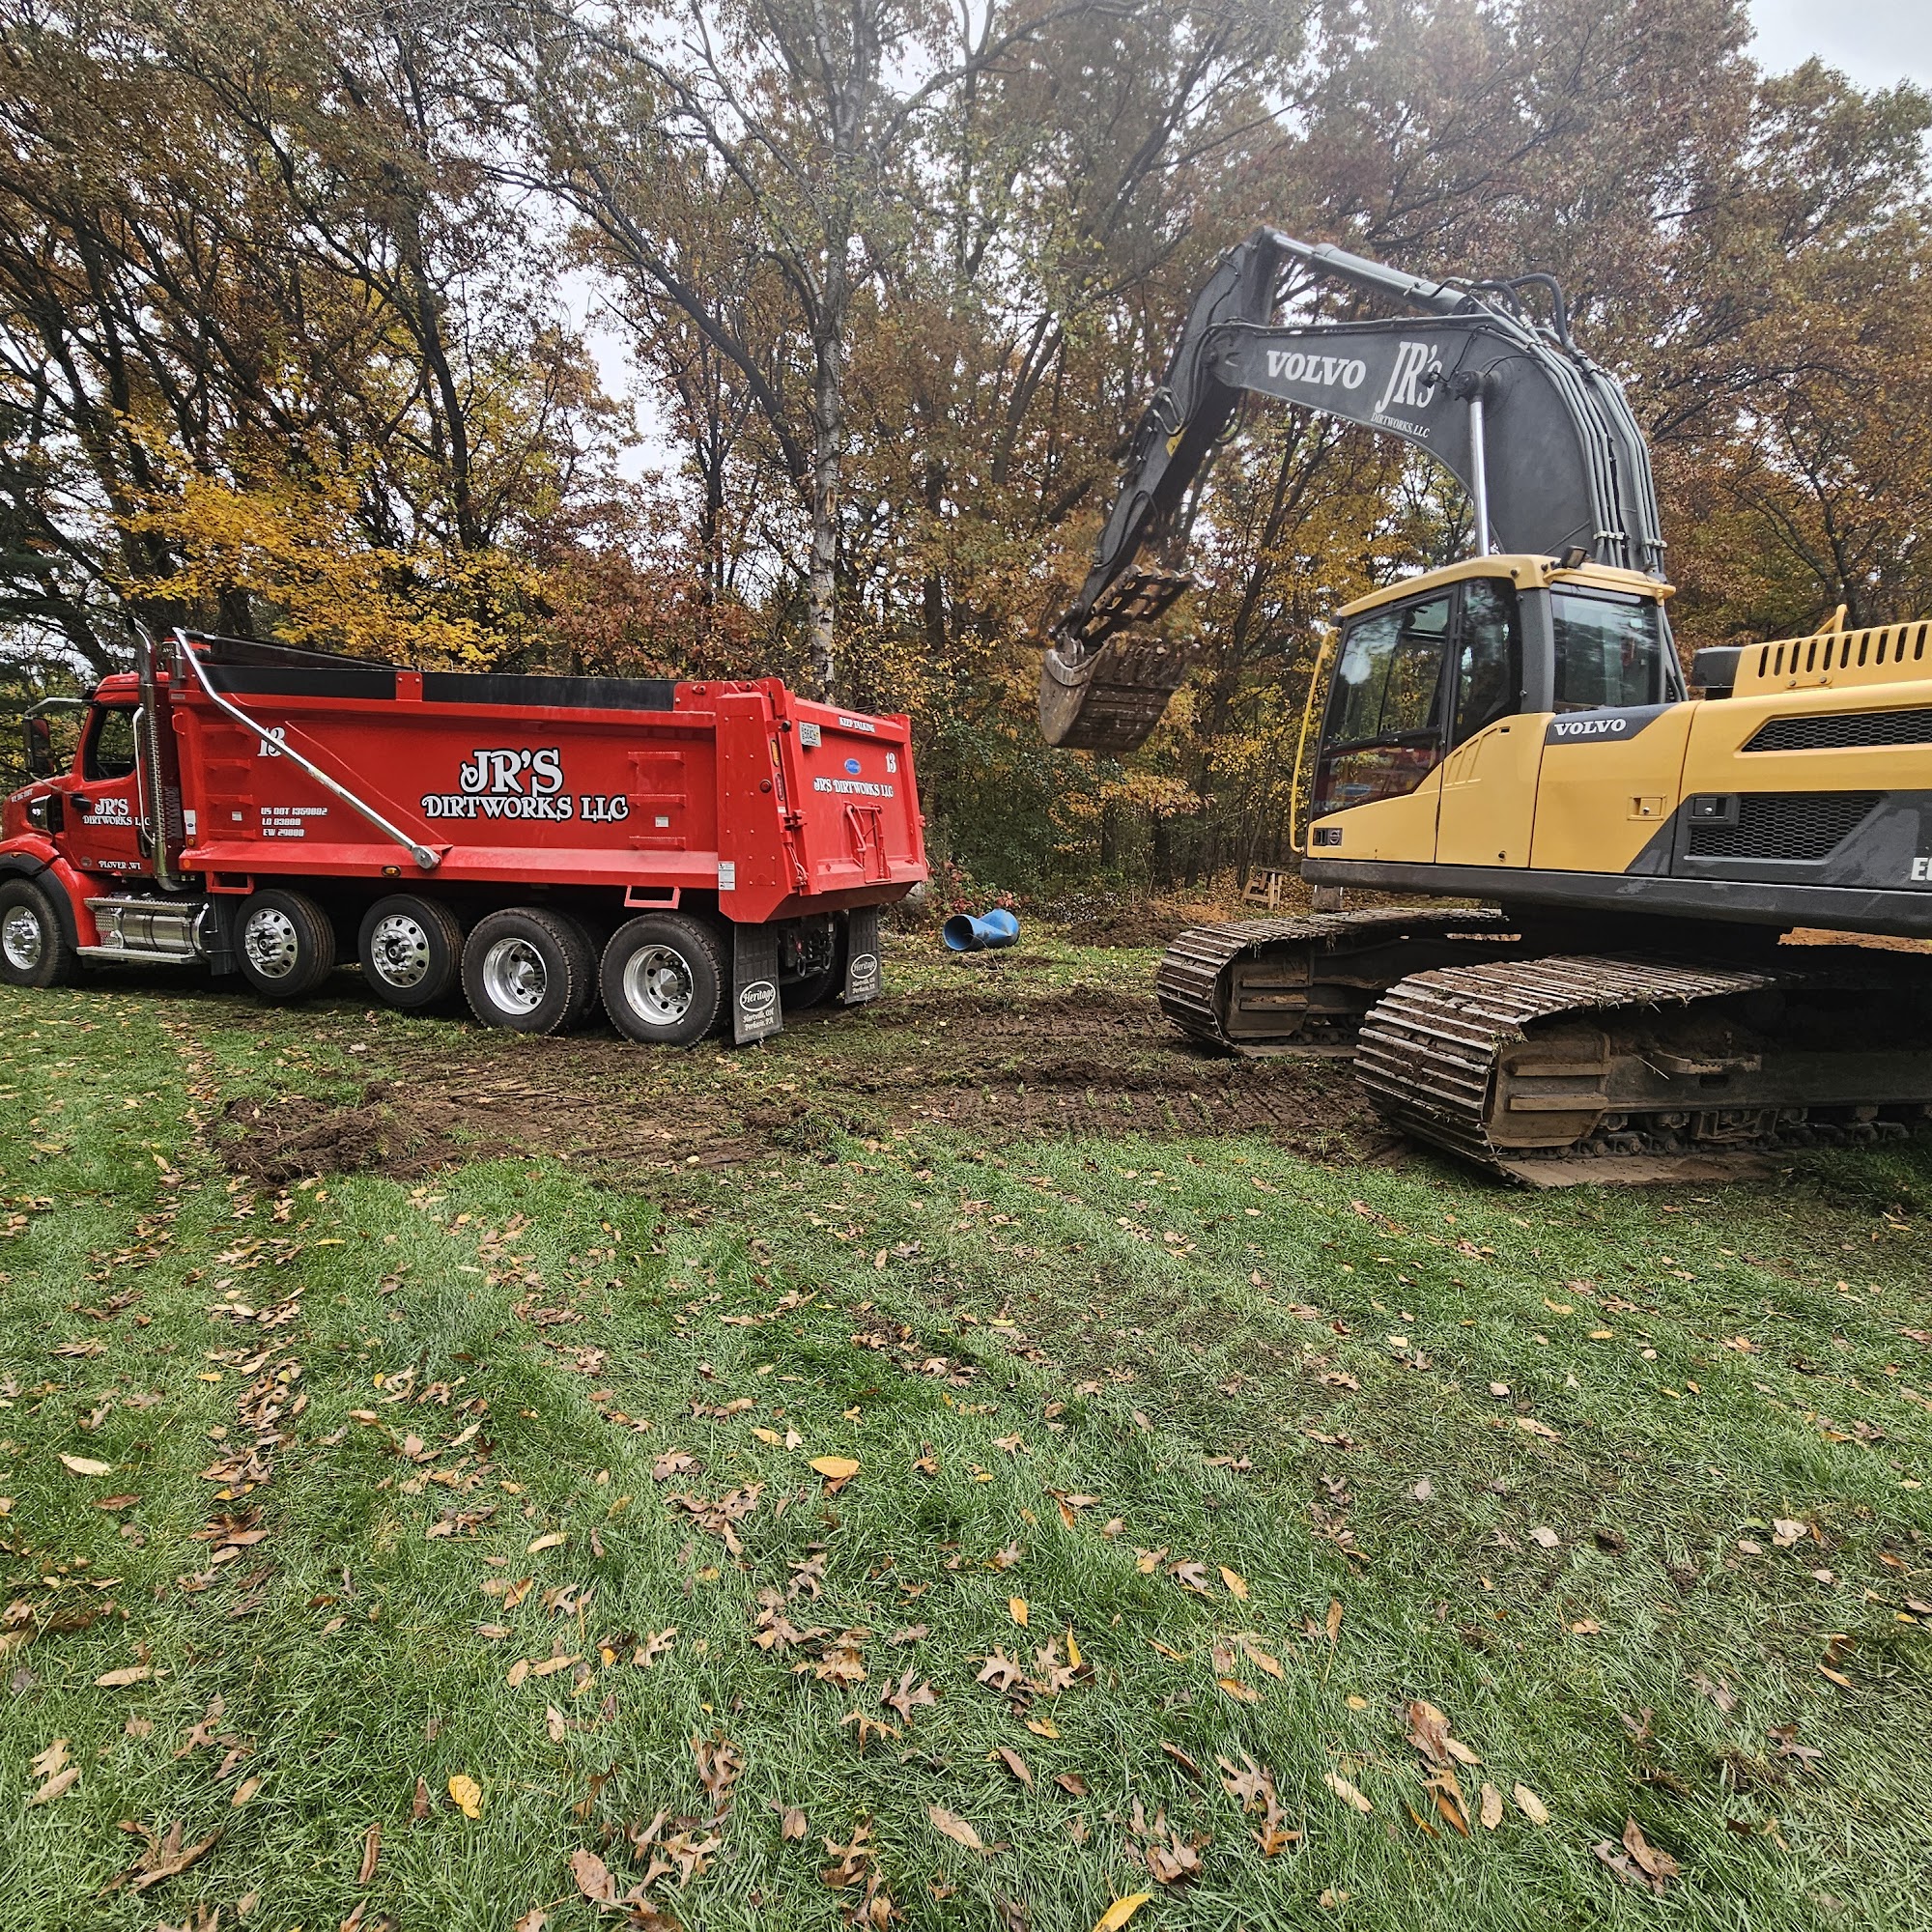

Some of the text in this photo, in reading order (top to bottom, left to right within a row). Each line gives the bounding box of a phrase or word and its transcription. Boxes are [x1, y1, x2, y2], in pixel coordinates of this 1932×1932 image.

[1266, 350, 1367, 389] VOLVO
[1413, 425, 1431, 438] LLC
[1554, 718, 1627, 736] VOLVO
[886, 753, 897, 774] 13
[460, 749, 563, 798] JR'S
[833, 780, 880, 796] DIRTWORKS
[881, 783, 894, 798] LLC
[95, 798, 129, 816] JR'S
[422, 796, 629, 822] DIRTWORKS LLC
[82, 814, 151, 826] DIRTWORKS LC
[99, 860, 127, 868] PLOVER
[1911, 857, 1932, 881] E
[742, 988, 774, 1005] Heritage
